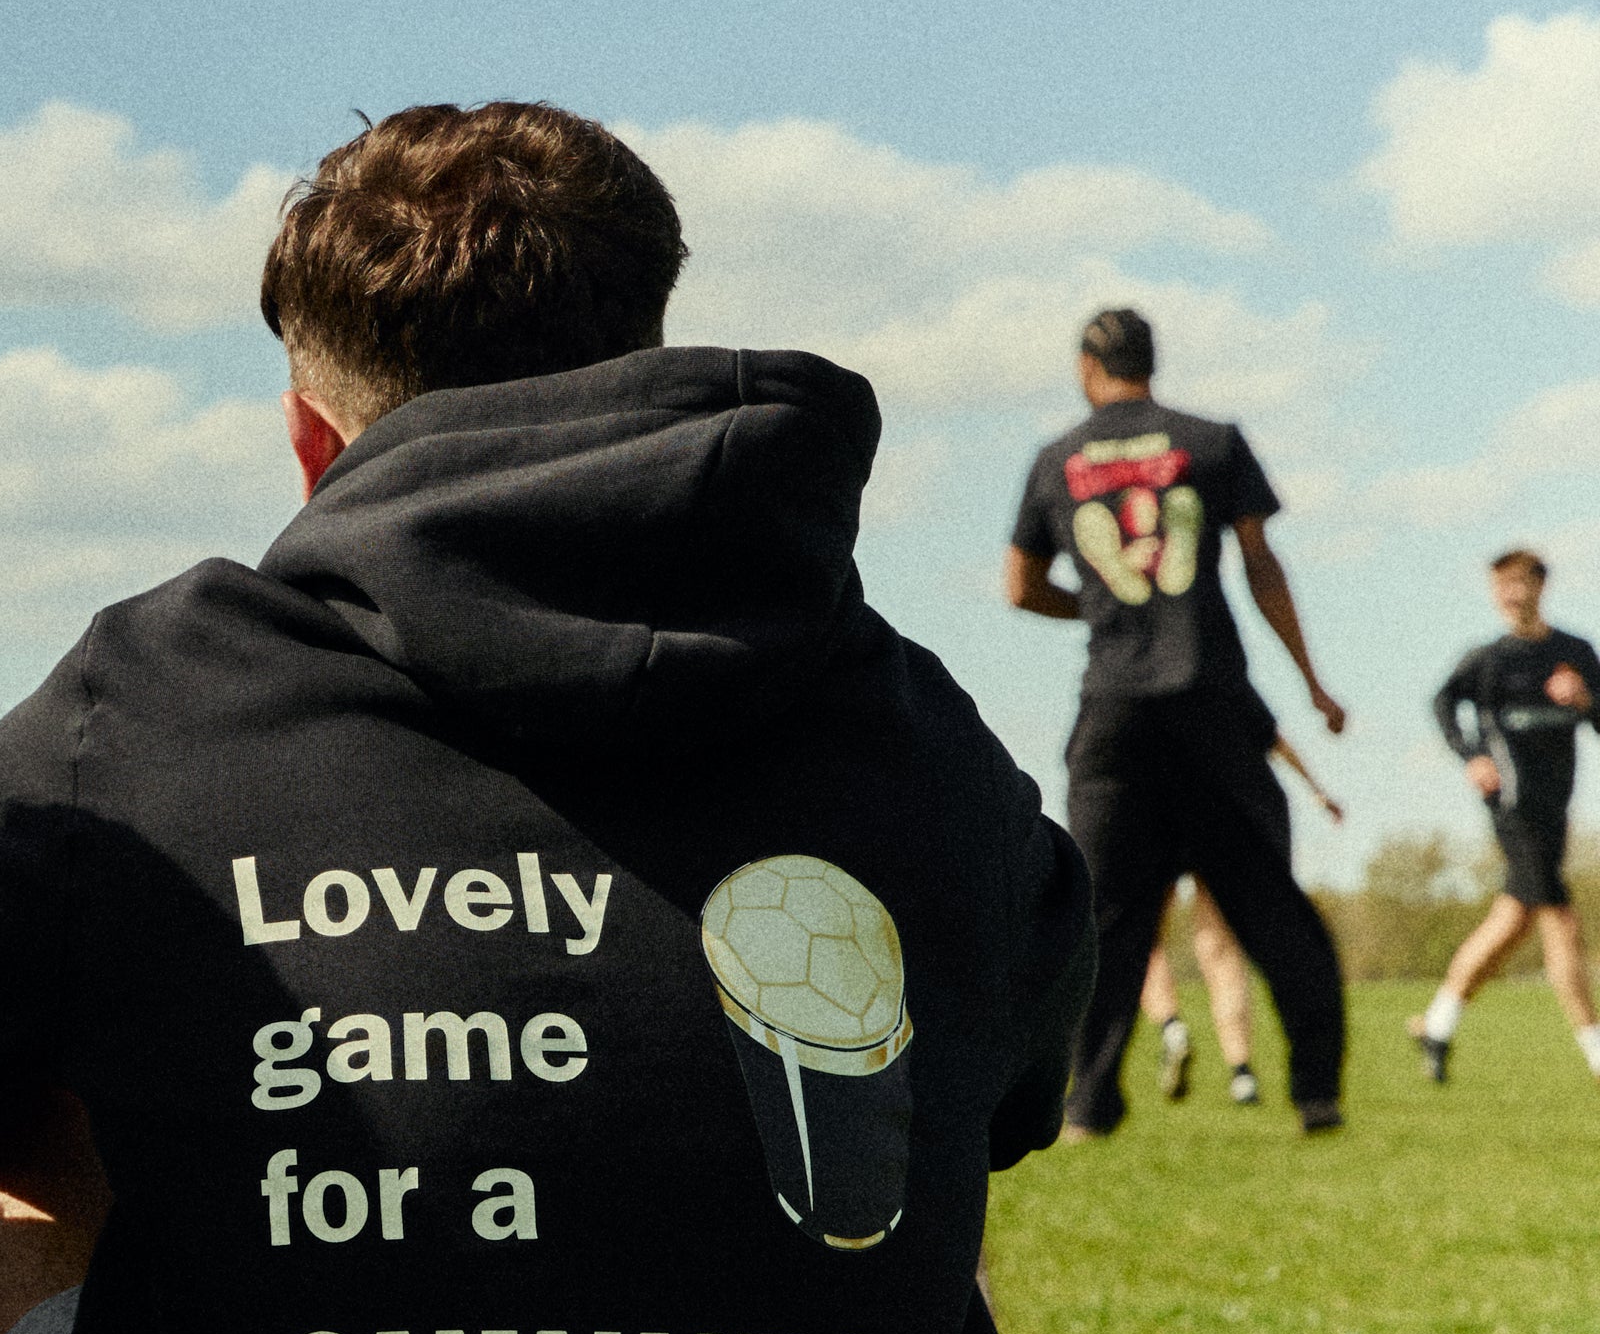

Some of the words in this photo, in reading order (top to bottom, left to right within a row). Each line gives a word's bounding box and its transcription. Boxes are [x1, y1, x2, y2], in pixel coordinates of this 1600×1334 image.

[232, 852, 613, 955] Lovely
[251, 1007, 589, 1111] game
[261, 1149, 419, 1247] for
[471, 1167, 538, 1240] a
